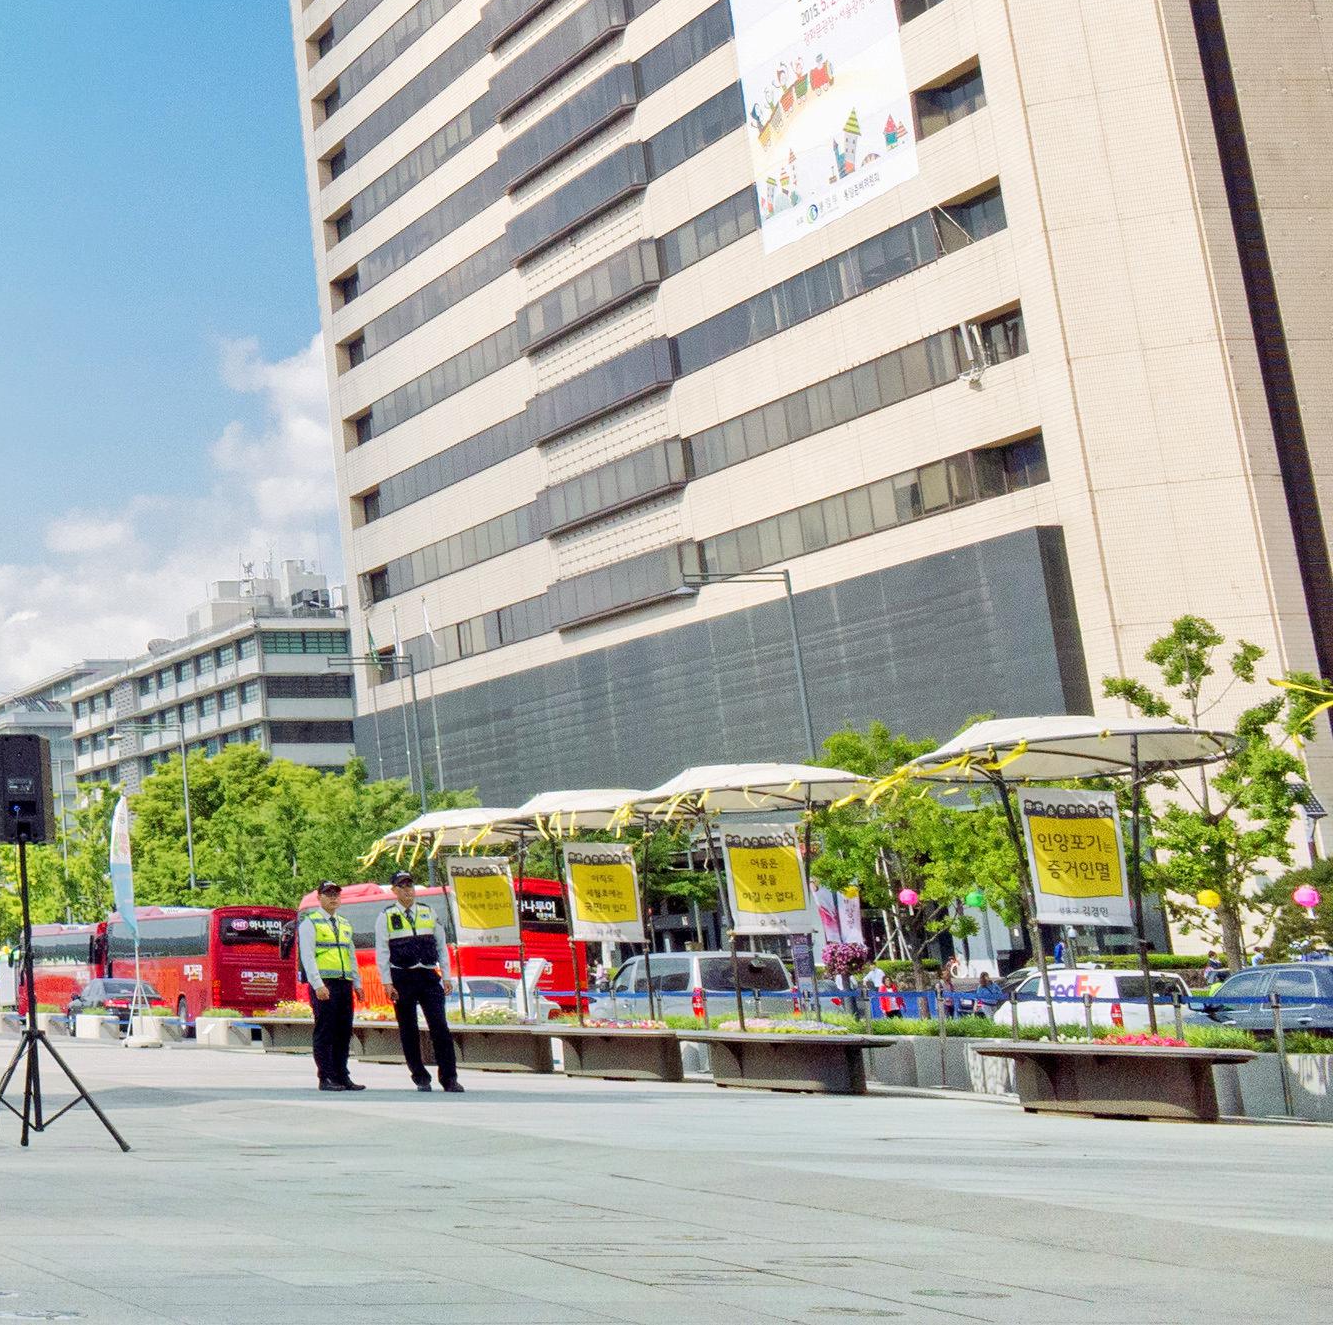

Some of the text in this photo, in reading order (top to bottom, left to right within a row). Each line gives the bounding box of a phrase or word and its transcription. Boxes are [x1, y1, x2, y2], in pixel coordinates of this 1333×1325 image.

[1047, 860, 1111, 882] 증거인멸
[756, 873, 778, 887] 빛을
[764, 892, 773, 903] 수
[249, 920, 282, 931] 하나투어
[1048, 974, 1101, 998] FedEx
